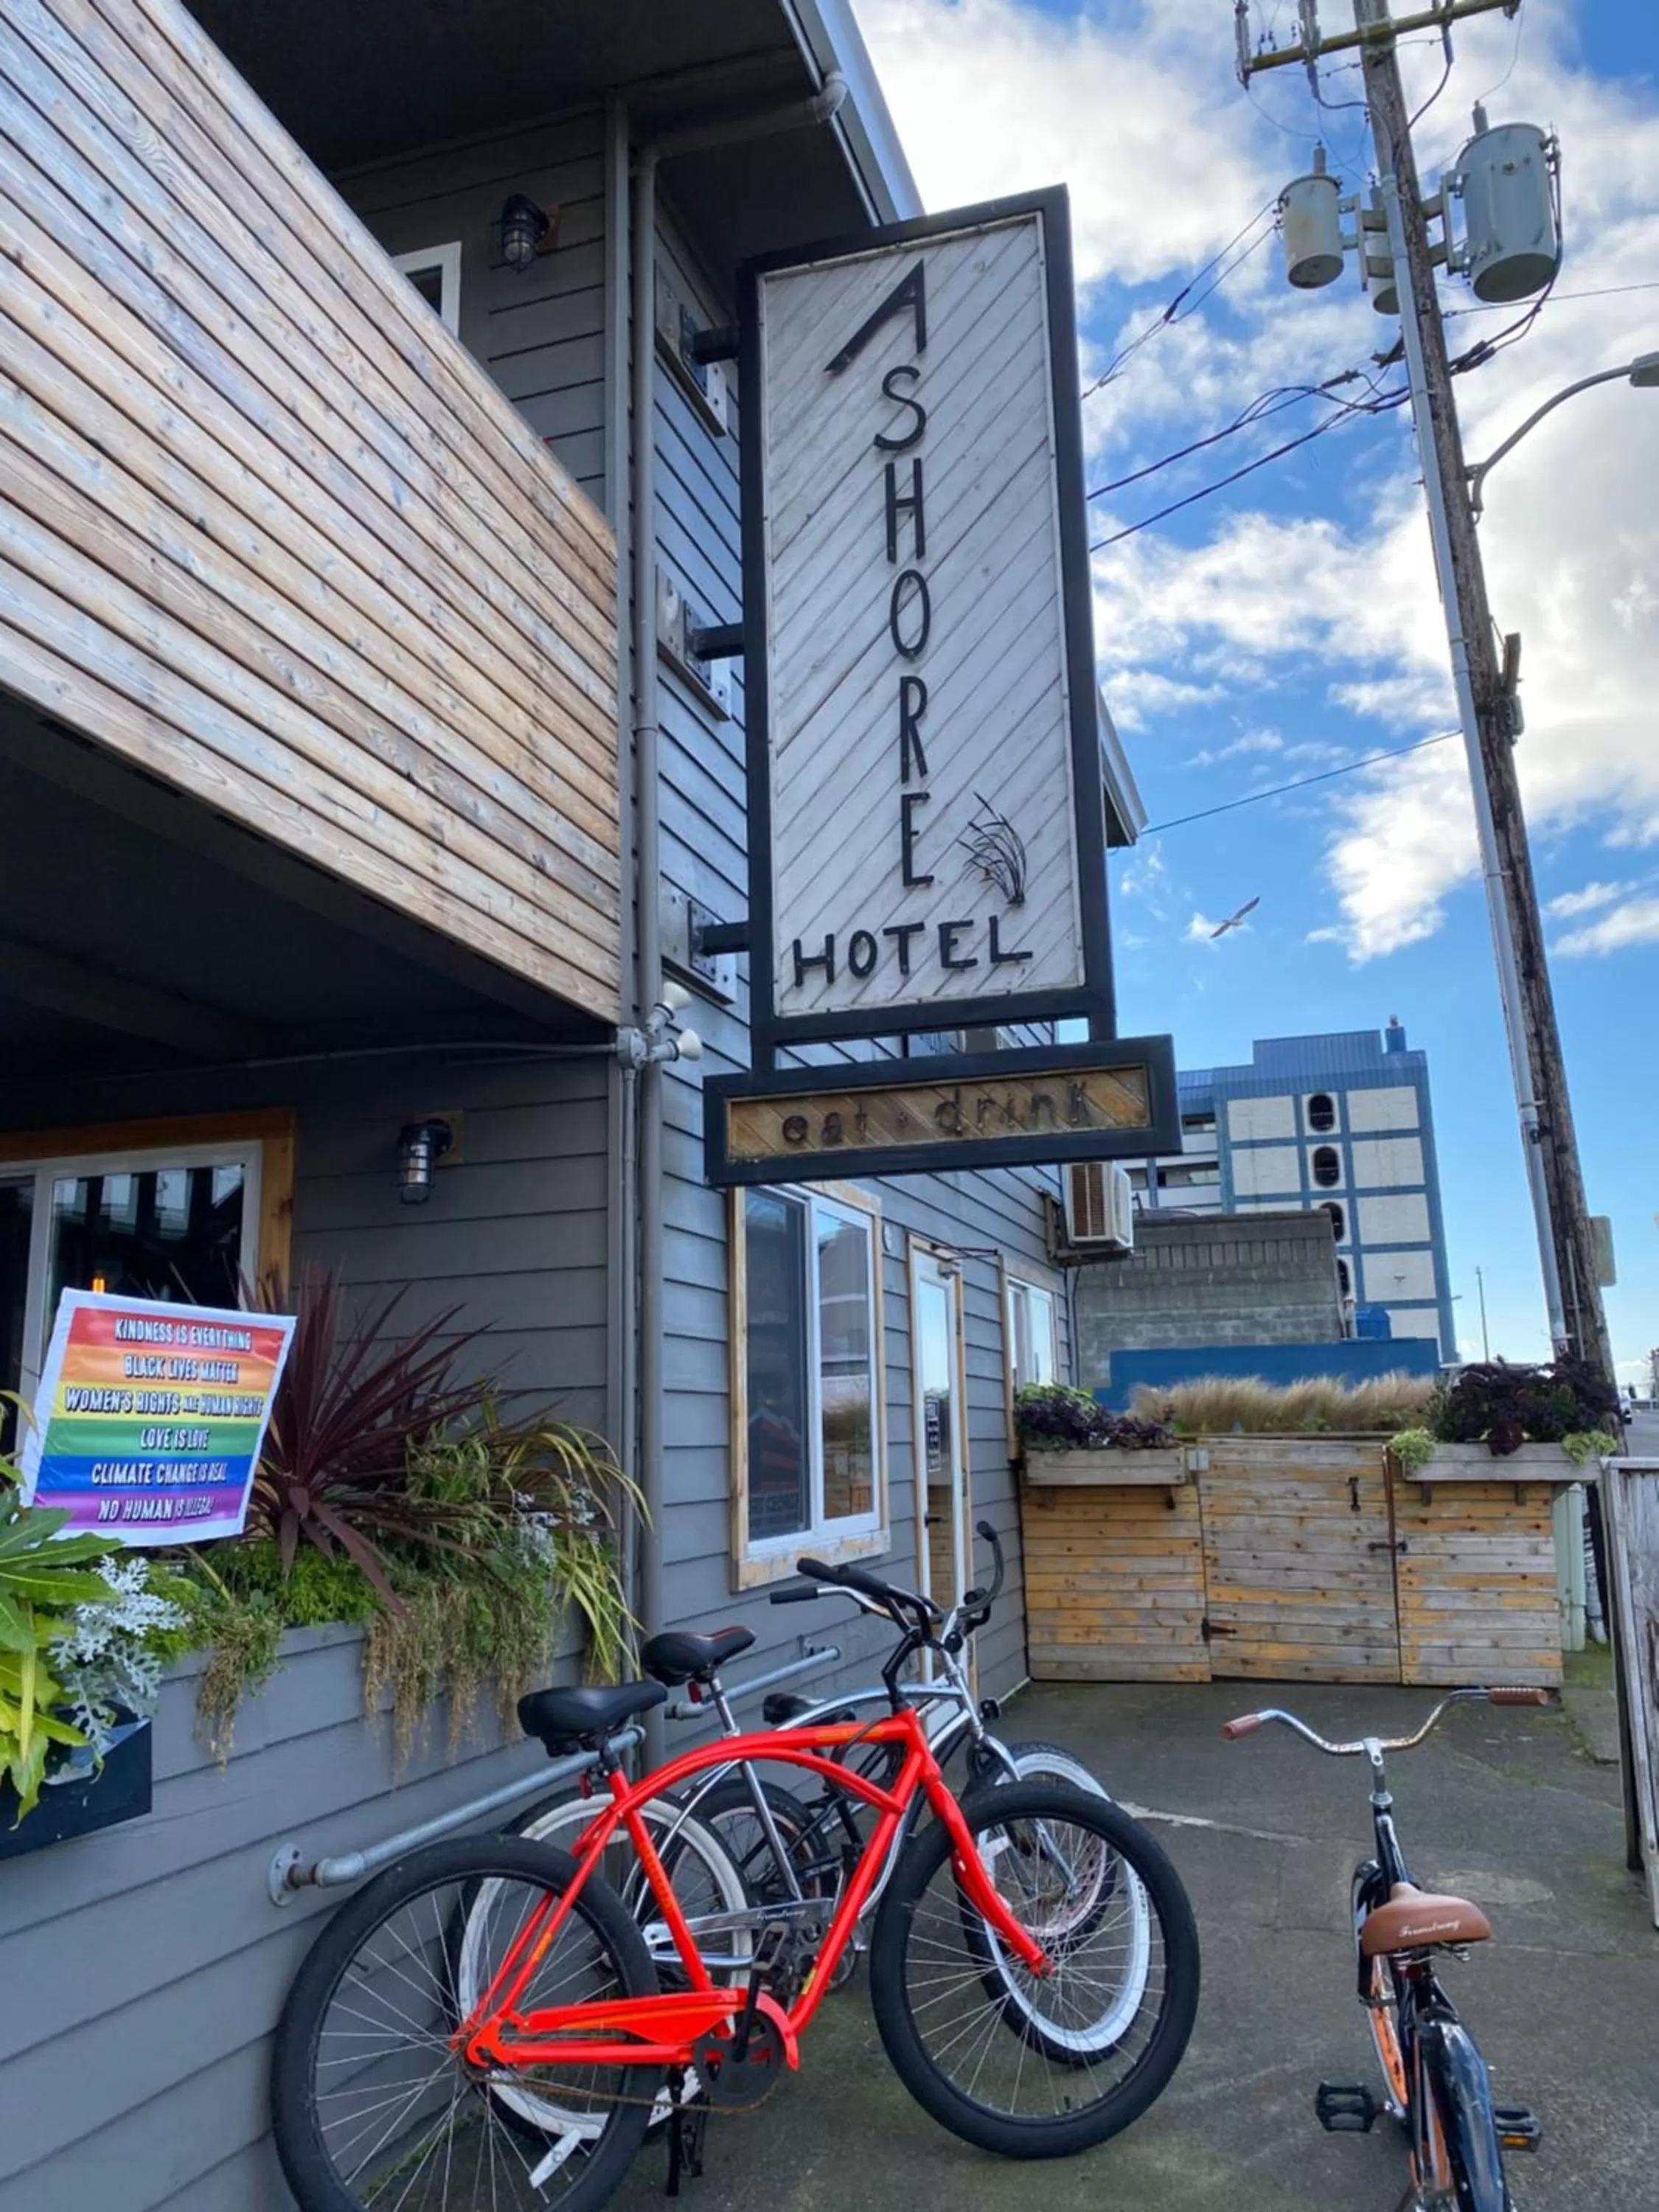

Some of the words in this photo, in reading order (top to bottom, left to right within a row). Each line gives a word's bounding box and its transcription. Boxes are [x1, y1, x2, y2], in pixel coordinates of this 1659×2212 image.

[824, 259, 934, 886] ASHORE
[793, 916, 1033, 987] HOTEL
[782, 1104, 869, 1145] eat
[934, 1079, 1091, 1136] drink
[115, 1318, 173, 1344] KINDNESS
[176, 1324, 189, 1345] IS
[191, 1326, 251, 1352] EVERYTHING
[124, 1354, 166, 1378] BLACK
[167, 1357, 198, 1380] LIVES
[200, 1361, 238, 1383] MATTER
[66, 1387, 133, 1413] WOMEN'S
[136, 1391, 180, 1416] RIGHTS
[141, 1427, 173, 1451] LOVE
[174, 1428, 187, 1452] IS
[187, 1430, 209, 1451] LOVE
[91, 1462, 153, 1486] CLIMATE
[156, 1461, 199, 1486] CHANGE
[97, 1499, 121, 1523] NO
[122, 1498, 173, 1523] HUMAN
[173, 1498, 186, 1520] IS
